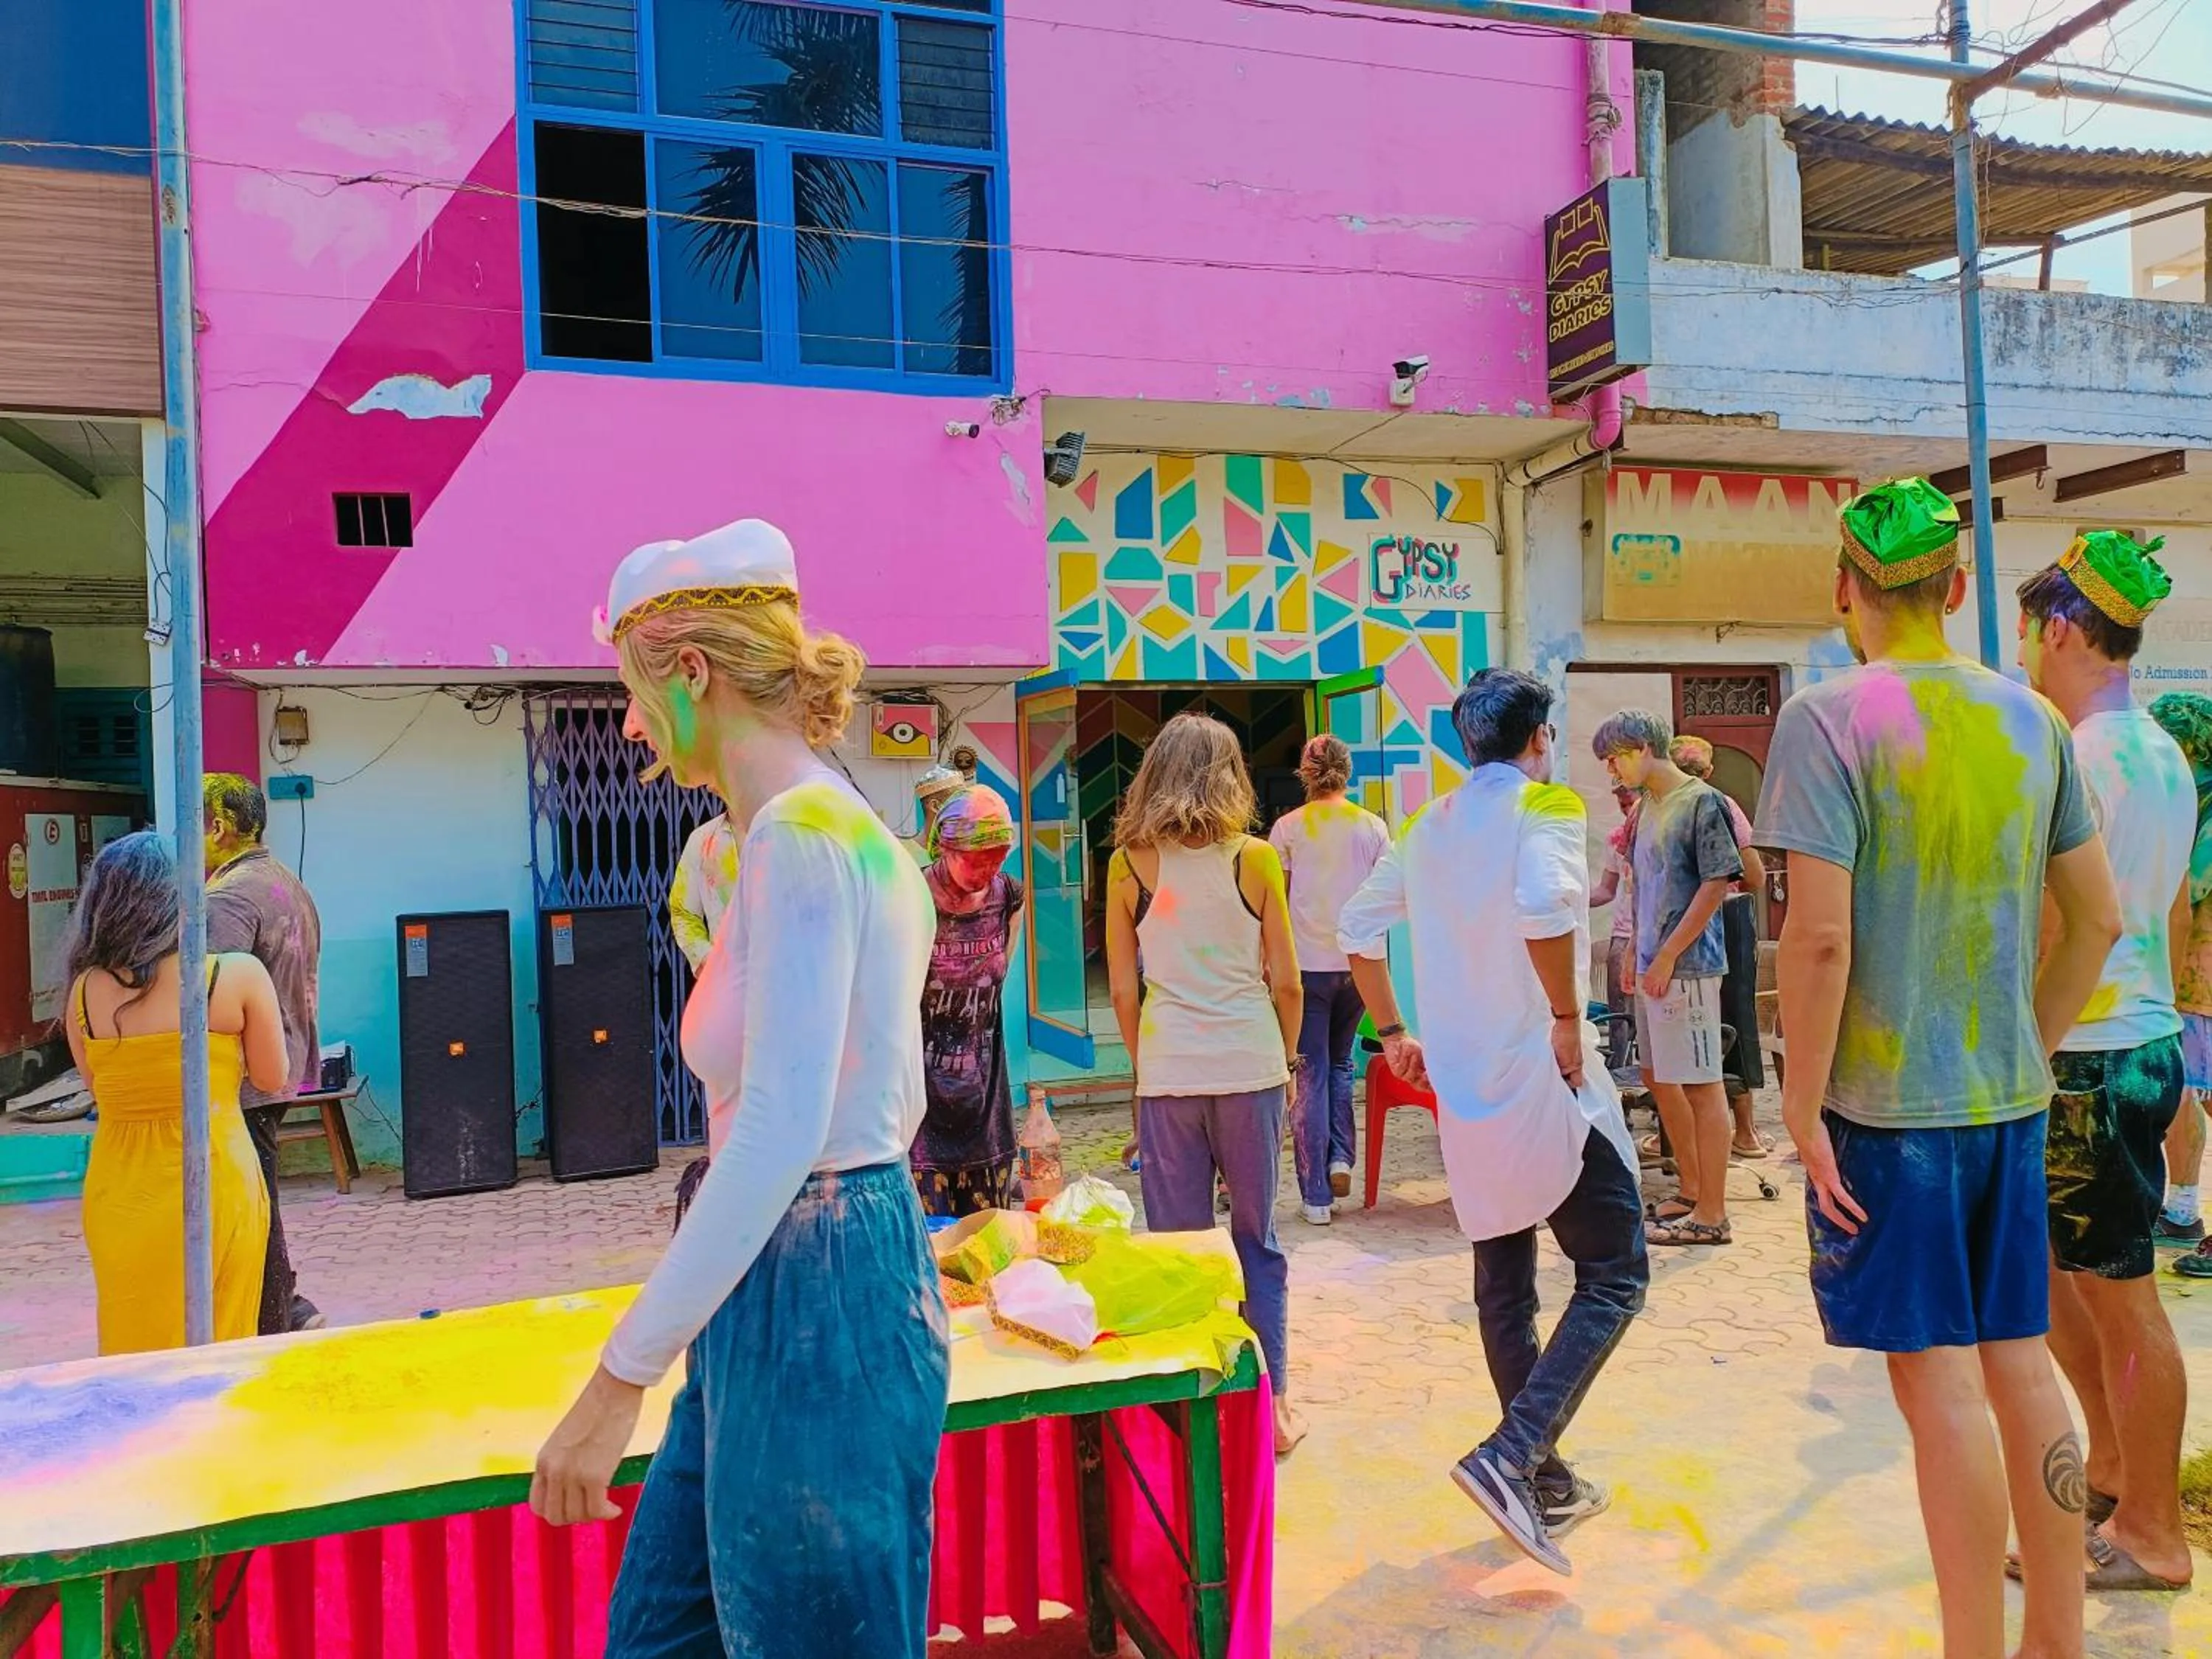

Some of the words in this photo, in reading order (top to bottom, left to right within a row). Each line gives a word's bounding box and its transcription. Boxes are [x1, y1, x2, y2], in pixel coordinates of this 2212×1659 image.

[1551, 268, 1607, 316] GYPSY
[1617, 471, 1852, 532] MAAN
[1371, 534, 1461, 604] GYPSY
[2144, 665, 2208, 679] Admission
